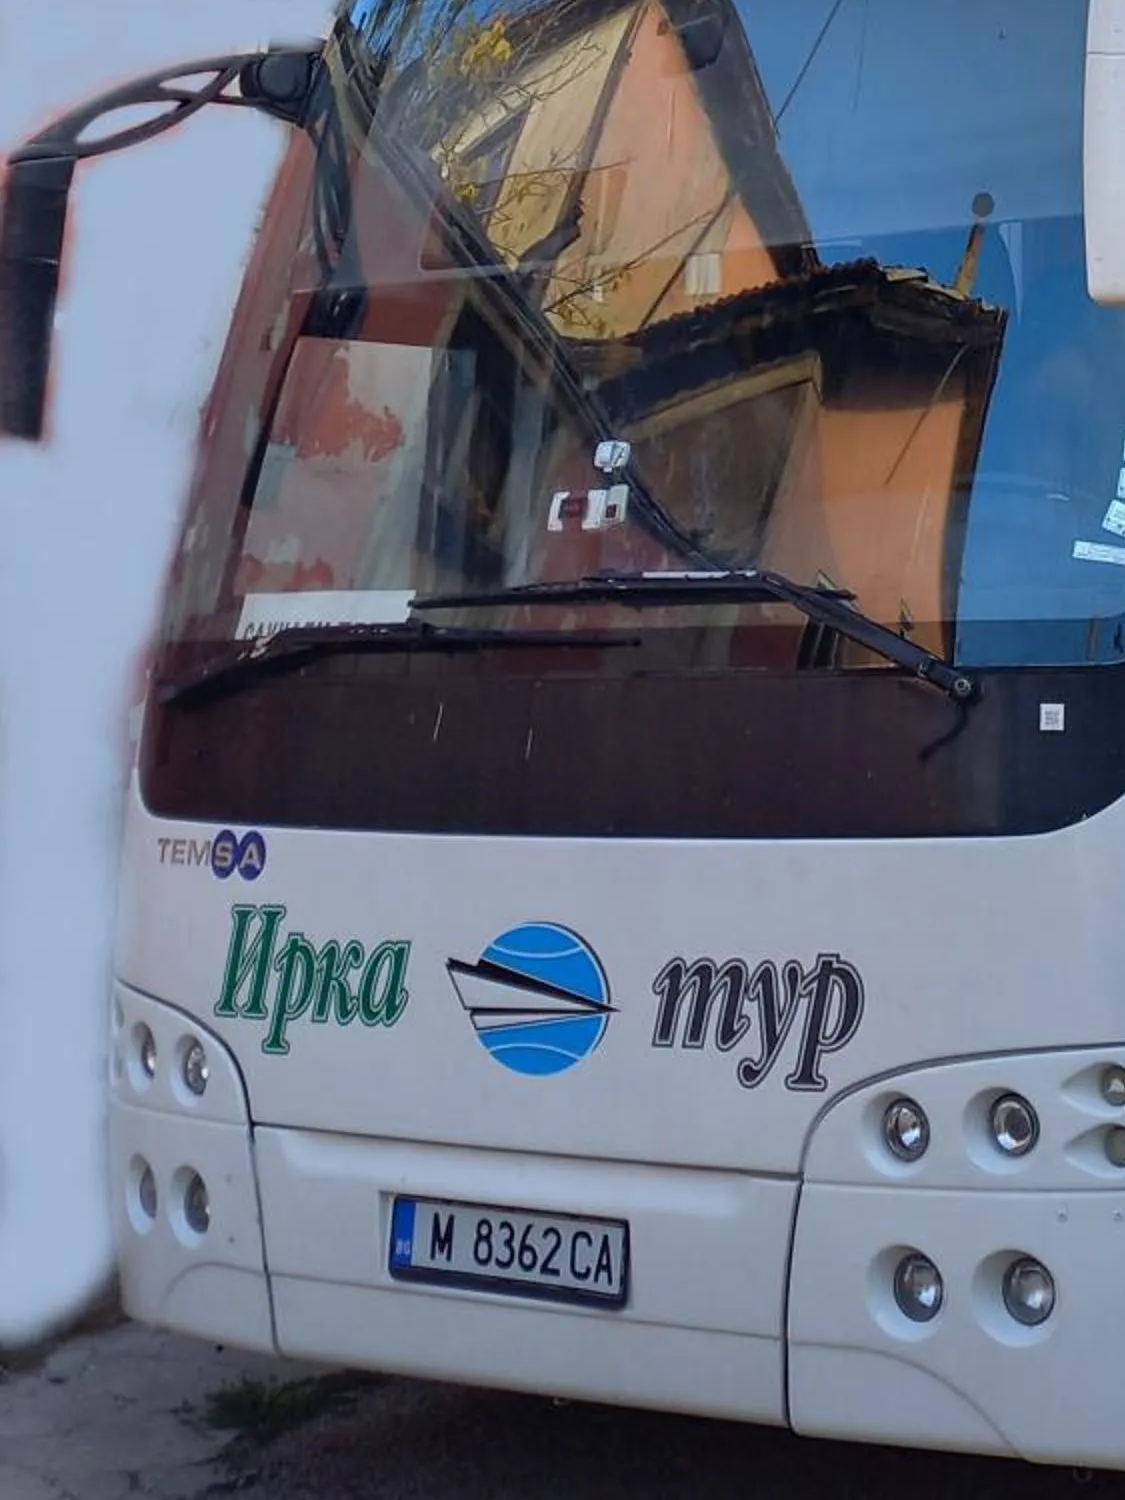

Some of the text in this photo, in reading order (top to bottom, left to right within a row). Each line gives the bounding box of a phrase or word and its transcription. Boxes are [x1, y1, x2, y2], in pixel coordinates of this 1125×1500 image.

[158, 831, 266, 877] TEMSA
[214, 903, 866, 1092] Ирка тур
